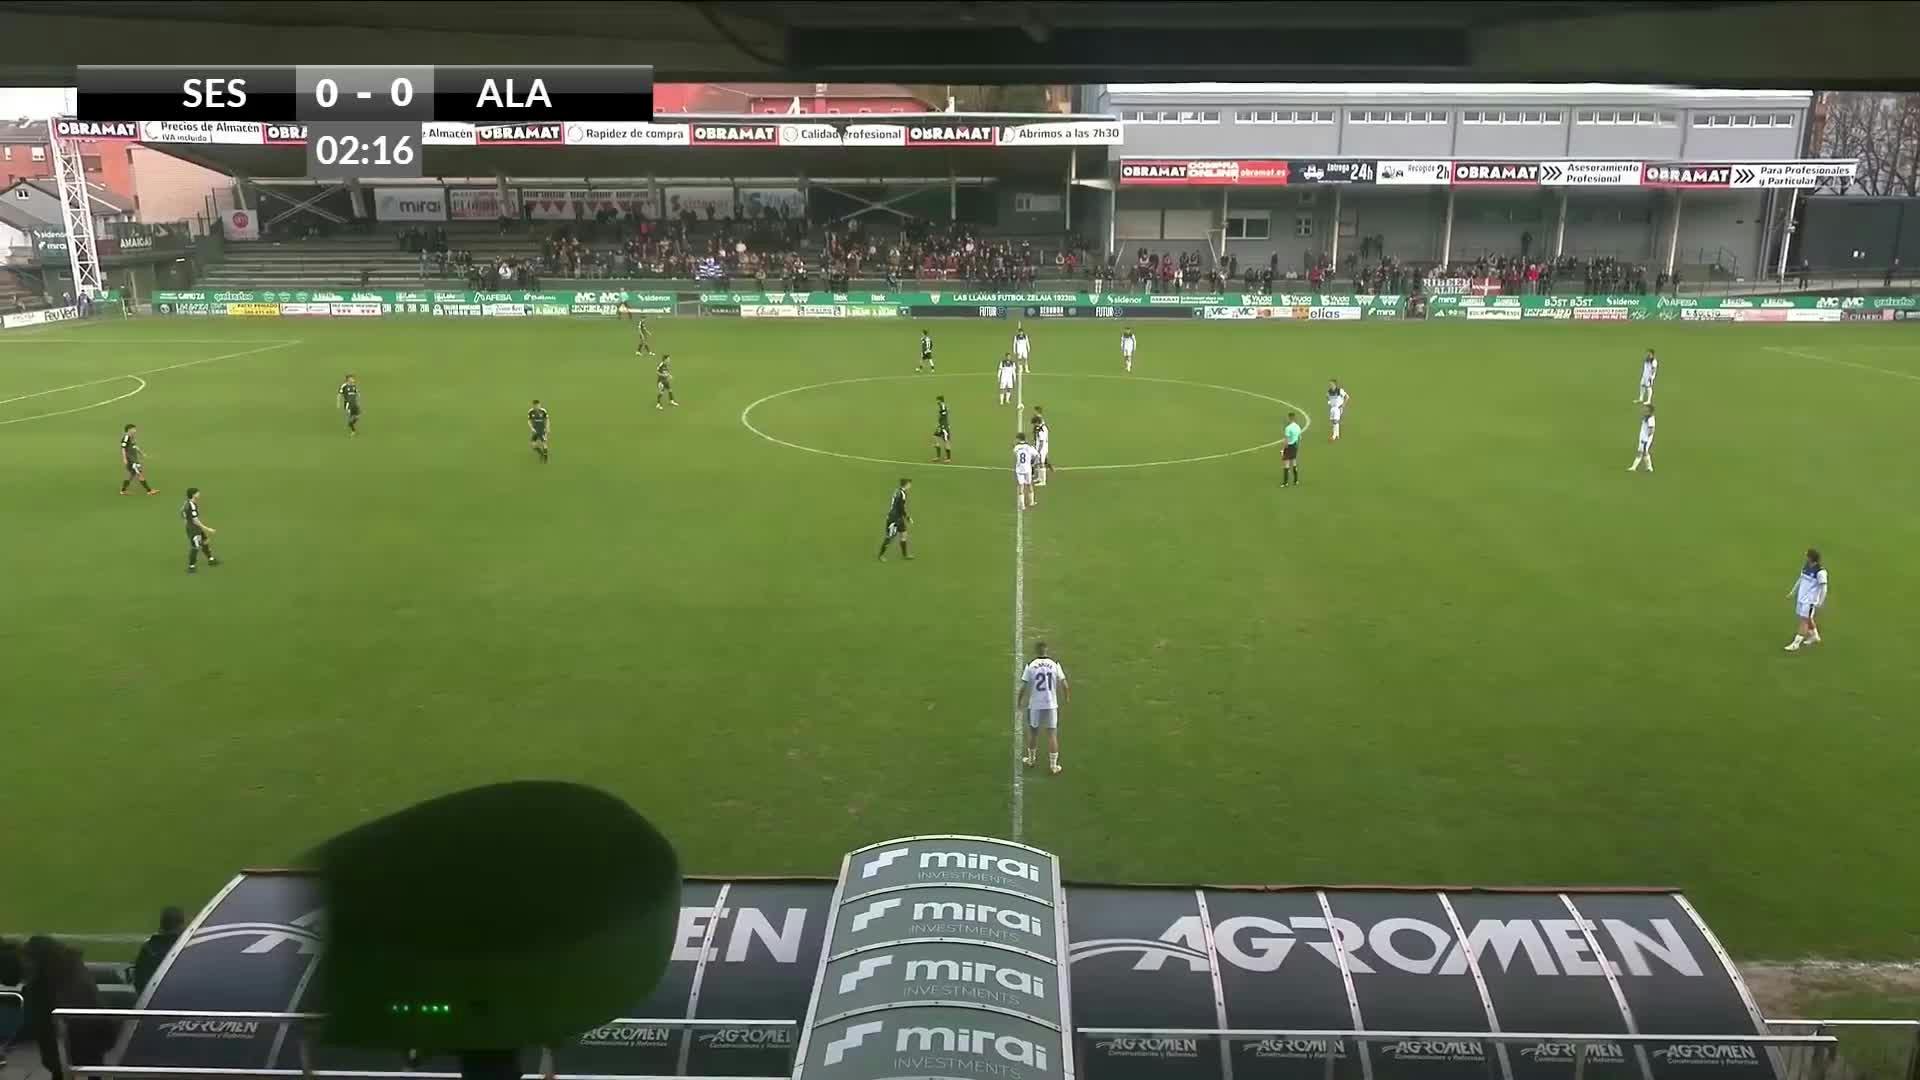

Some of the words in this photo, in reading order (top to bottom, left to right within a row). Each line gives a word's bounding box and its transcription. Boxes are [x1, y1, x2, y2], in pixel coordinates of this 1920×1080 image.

[57, 121, 136, 137] OBRAMAT
[161, 122, 199, 132] Precios
[201, 121, 213, 133] de
[480, 125, 560, 140] OBRAMAT
[694, 127, 774, 140] OBRAMAT
[801, 129, 838, 139] Calidad
[910, 127, 991, 141] OBRAMAT
[1018, 129, 1063, 138] Abrimos
[1075, 129, 1090, 138] las
[1093, 128, 1119, 138] 7h30
[586, 128, 627, 141] Rapidez
[630, 128, 642, 138] de
[645, 131, 684, 141] compra
[1123, 166, 1187, 177] OBRAMAT
[1240, 167, 1286, 177] obramat.es
[1327, 163, 1349, 173] Entrega
[1350, 164, 1373, 180] 24h
[1436, 164, 1450, 180] 2h
[1456, 164, 1537, 179] OBRAMAT
[1567, 163, 1639, 172] Asesoramiento
[1646, 166, 1729, 183] OBRAMAT
[1760, 166, 1782, 174] Para
[1785, 166, 1850, 175] Profesionales
[1566, 174, 1621, 183] Profesional
[1759, 178, 1765, 186] y
[399, 200, 441, 213] mirai
[1114, 296, 1142, 304] sidenor
[1613, 297, 1639, 305] sidenor
[44, 311, 59, 321] Feu
[60, 307, 77, 319] Vert
[1019, 452, 1026, 464] 8
[1035, 672, 1052, 692] 21
[919, 851, 1040, 883] mirai
[918, 871, 1016, 886] INVESTMENTS
[913, 902, 1042, 937] mirai
[910, 924, 1019, 941] INVESTMENTS
[1133, 916, 1704, 976] AGROMEN
[905, 959, 1045, 998] mirai
[904, 985, 1020, 1006] INVESTMENTS
[173, 1020, 259, 1033] AGROMEN
[582, 1028, 670, 1041] AGROMEN
[895, 1027, 1047, 1072] mirai
[1110, 1038, 1197, 1051] AGROMEN
[1395, 1041, 1483, 1055] AGROMEN
[1667, 1044, 1756, 1058] AGROMEN
[894, 1057, 1023, 1079] INVESTMENTS
